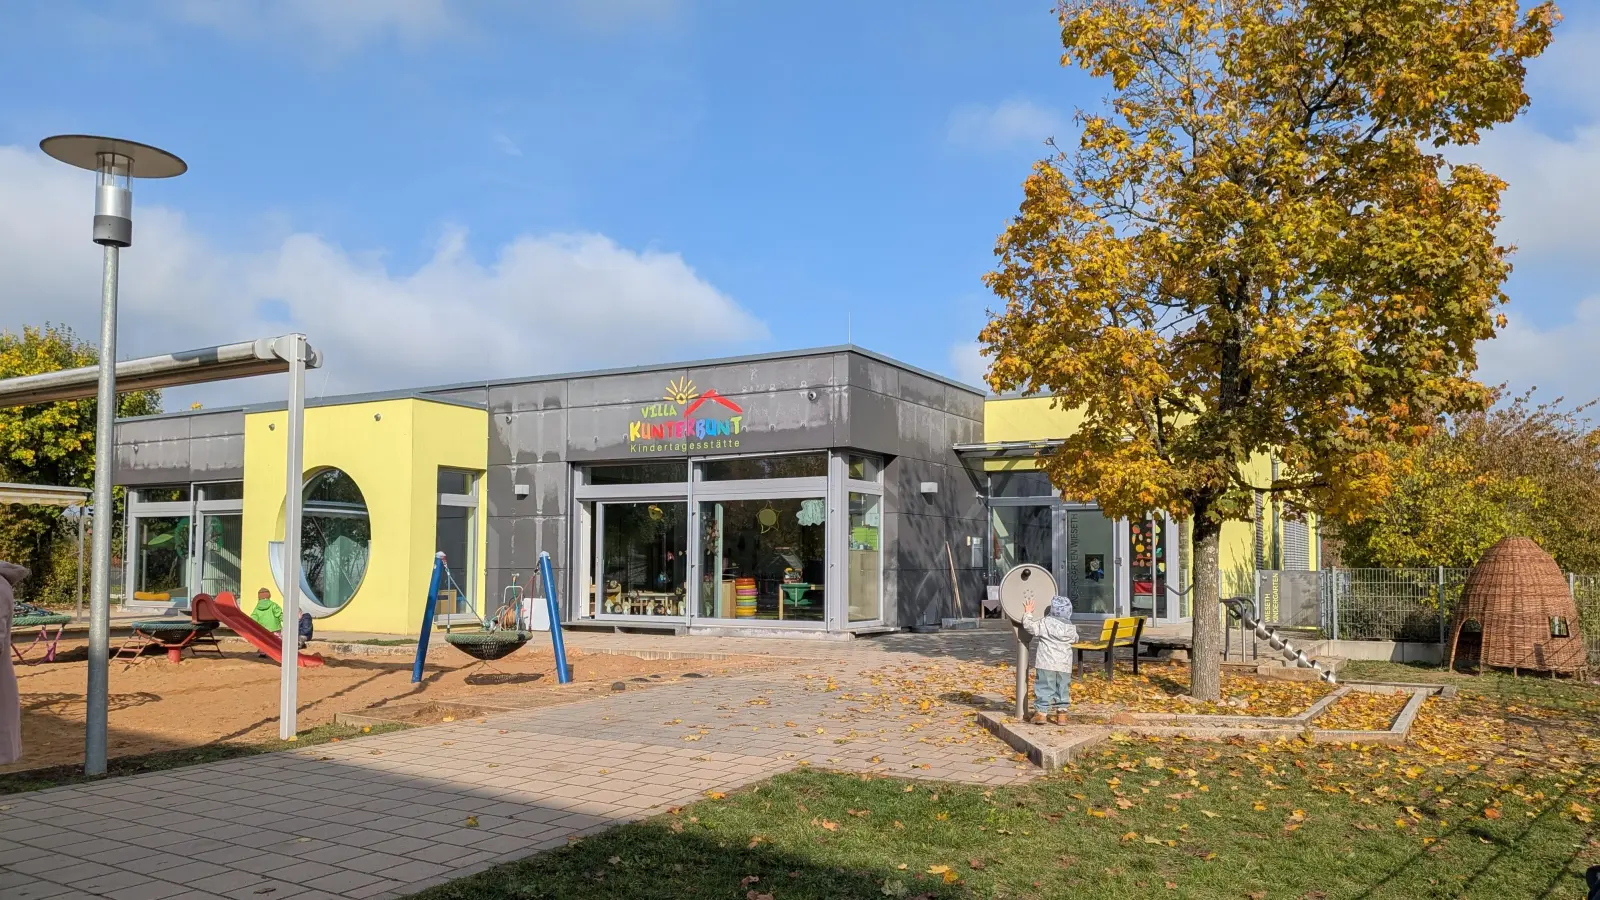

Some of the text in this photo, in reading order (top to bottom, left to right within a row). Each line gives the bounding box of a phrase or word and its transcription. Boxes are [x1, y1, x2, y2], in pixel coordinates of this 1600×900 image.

[641, 404, 677, 418] VILLA
[629, 416, 742, 441] KUNTERBUNT
[630, 439, 740, 453] Kindertagesstätte
[1070, 513, 1079, 547] WIESETH
